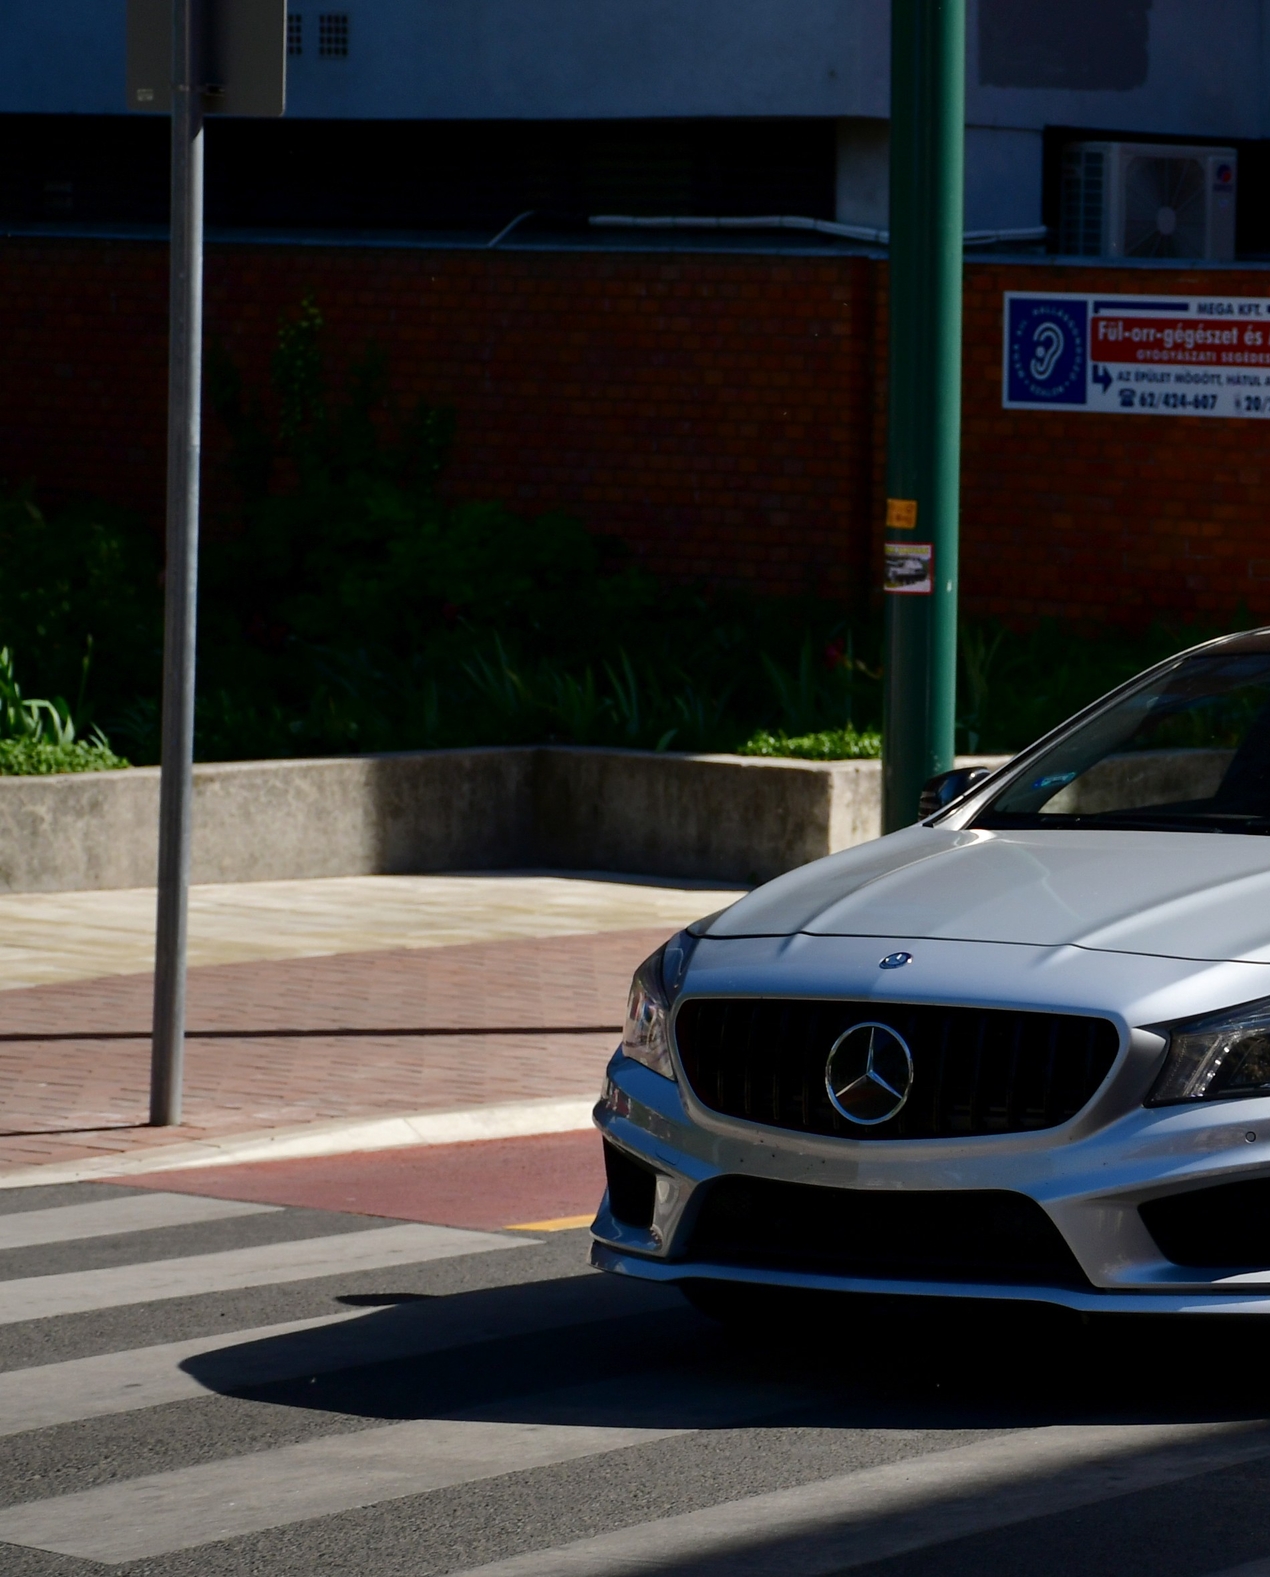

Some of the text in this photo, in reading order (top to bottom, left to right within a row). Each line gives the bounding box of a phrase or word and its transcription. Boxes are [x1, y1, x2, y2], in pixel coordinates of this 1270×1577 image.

[1197, 302, 1234, 315] MEGA
[1098, 320, 1239, 349] Fül-orr-gégészet
[1244, 324, 1264, 346] és
[1136, 349, 1217, 362] GYÓGYÁSZATI
[1117, 371, 1132, 382] AZ
[1226, 373, 1261, 387] HÁTUL
[1138, 391, 1218, 410] 62/424-607
